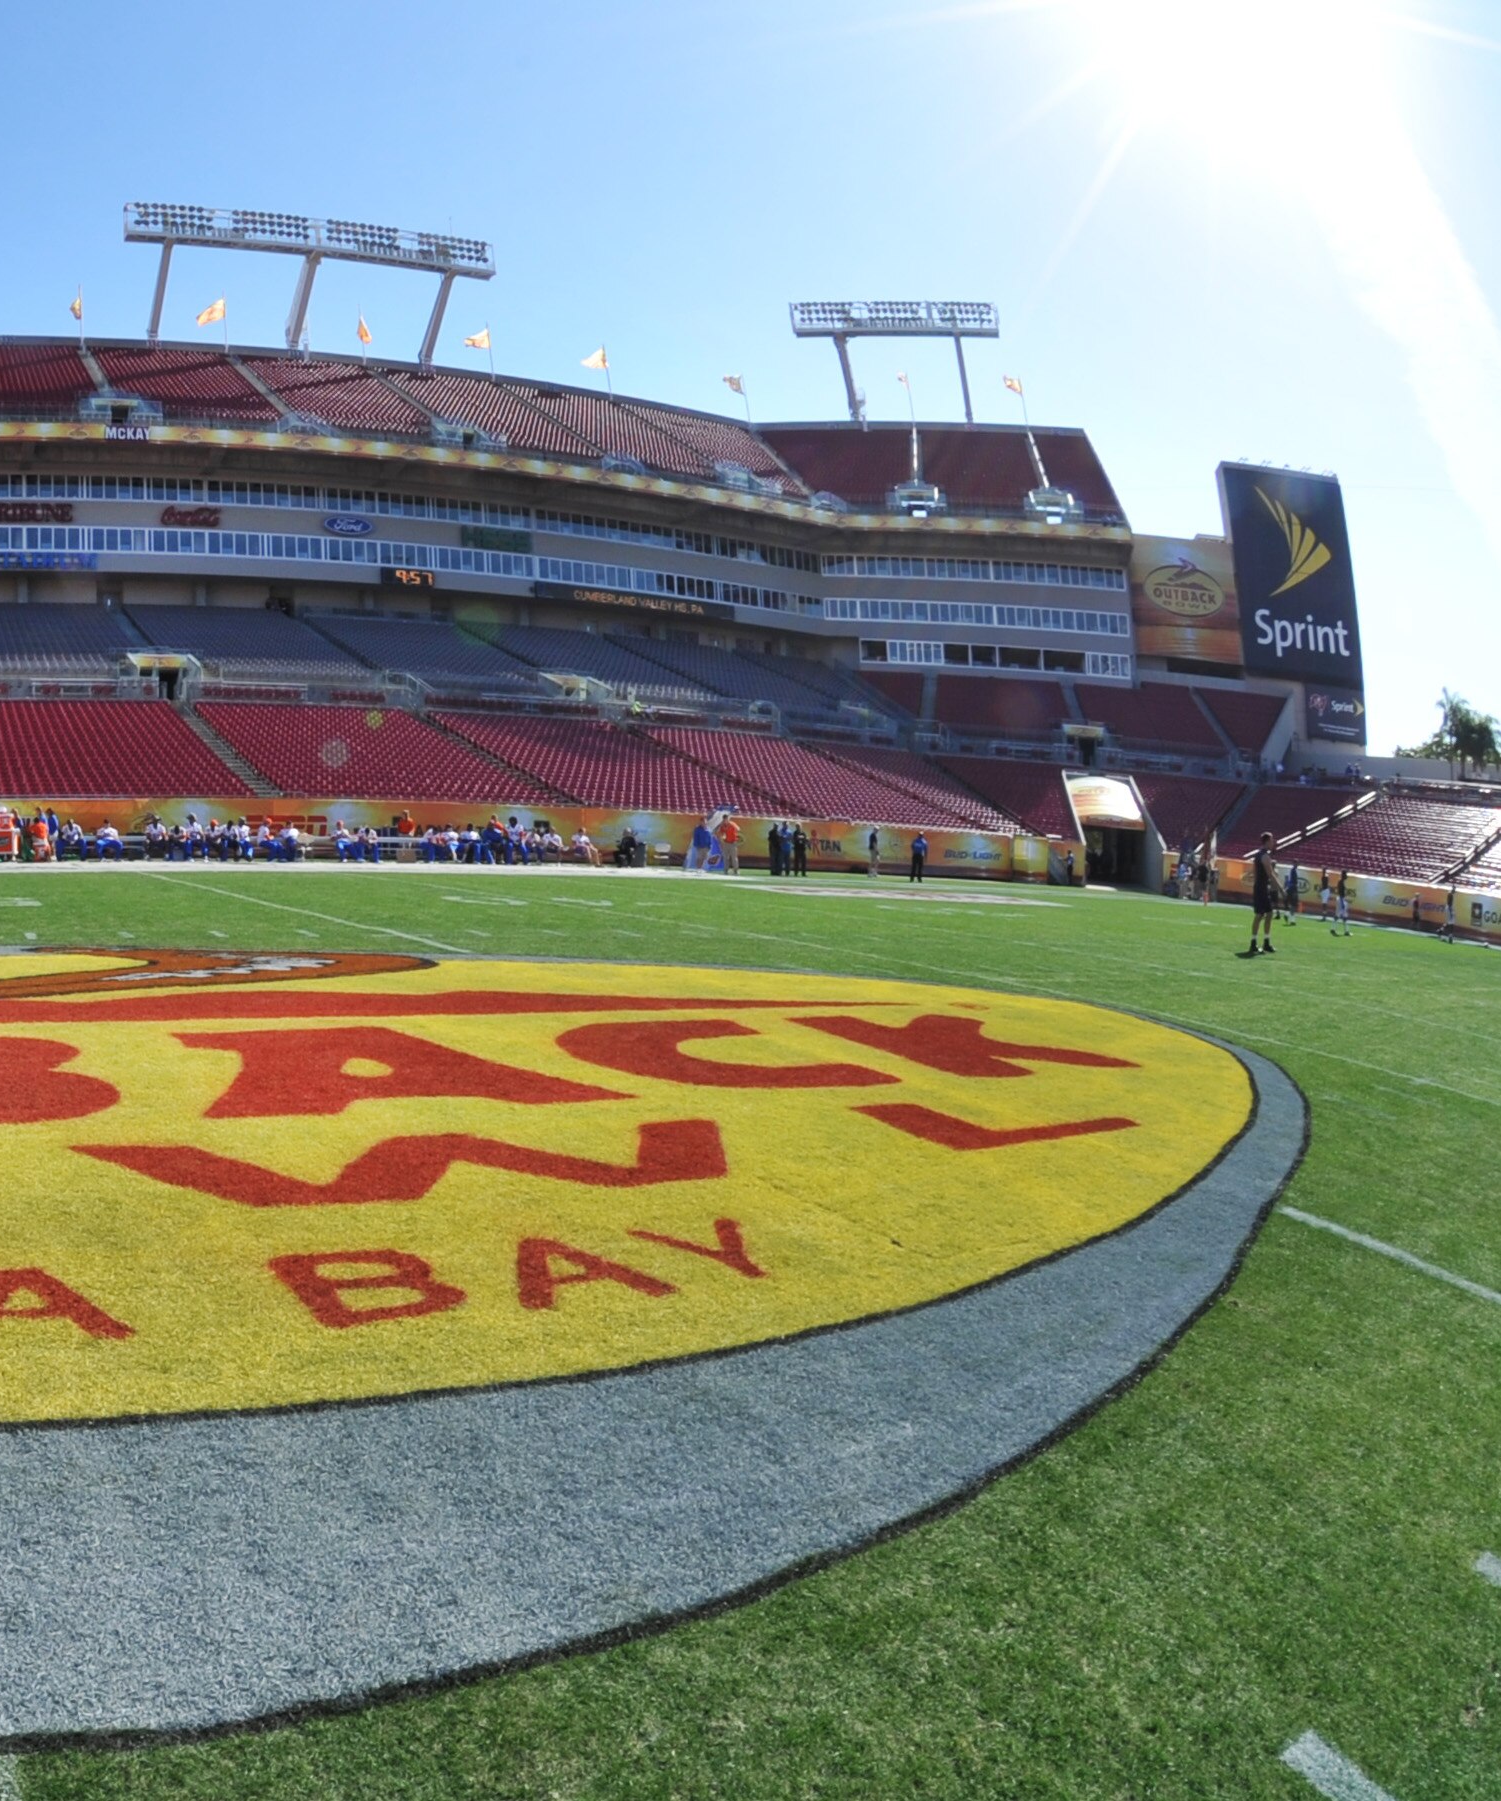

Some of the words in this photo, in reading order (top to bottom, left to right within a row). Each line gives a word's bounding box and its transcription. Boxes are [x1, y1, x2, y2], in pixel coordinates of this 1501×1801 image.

[105, 426, 150, 441] MCKAY
[333, 517, 364, 533] Ford
[573, 590, 638, 607] CUMBERLAND
[1153, 586, 1217, 605] OUTBACK
[1254, 608, 1351, 657] Sprint
[1331, 700, 1355, 713] Sprint
[269, 1218, 768, 1331] BAY
